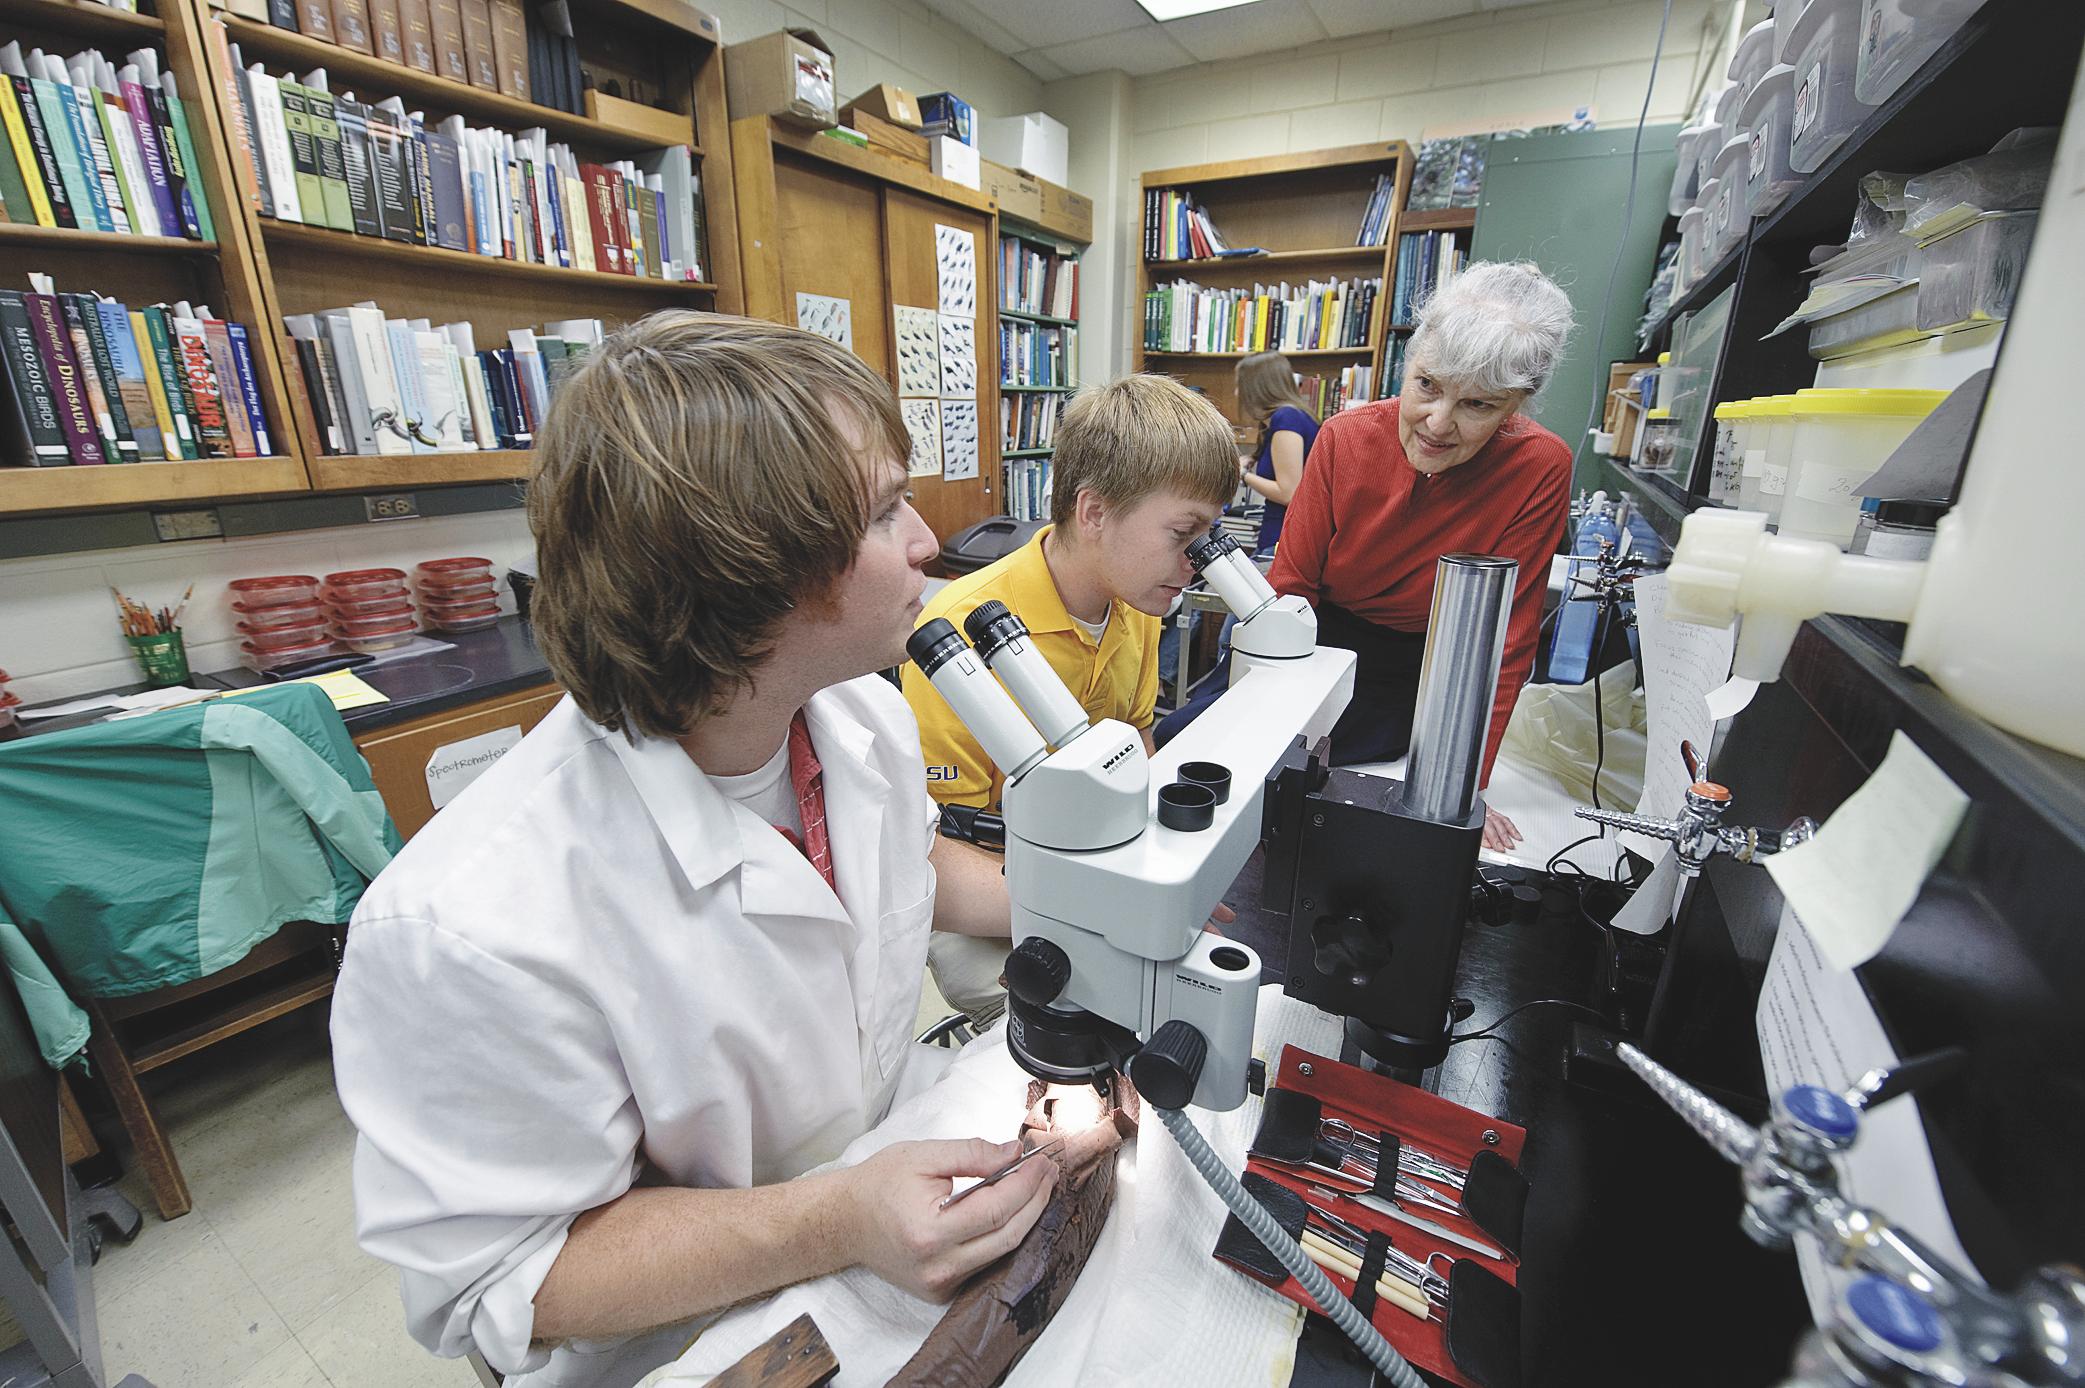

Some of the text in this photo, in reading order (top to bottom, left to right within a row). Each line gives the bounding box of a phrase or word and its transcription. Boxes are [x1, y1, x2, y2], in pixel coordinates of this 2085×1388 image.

[138, 120, 166, 186] ADAPTATION
[163, 126, 184, 178] Biogeography
[114, 311, 126, 332] THE
[38, 300, 89, 434] Encyclopedia of DINOSAURS
[157, 347, 169, 360] The
[15, 327, 56, 429] MESOZOIC BIRDS
[98, 349, 111, 367] LOST
[105, 370, 119, 397] WORLD
[162, 363, 173, 380] Rise
[181, 335, 221, 428] DINOSAUR
[166, 382, 178, 391] of
[169, 392, 183, 411] Birds
[1102, 743, 1134, 770] WILD
[1175, 973, 1222, 991] WILD
